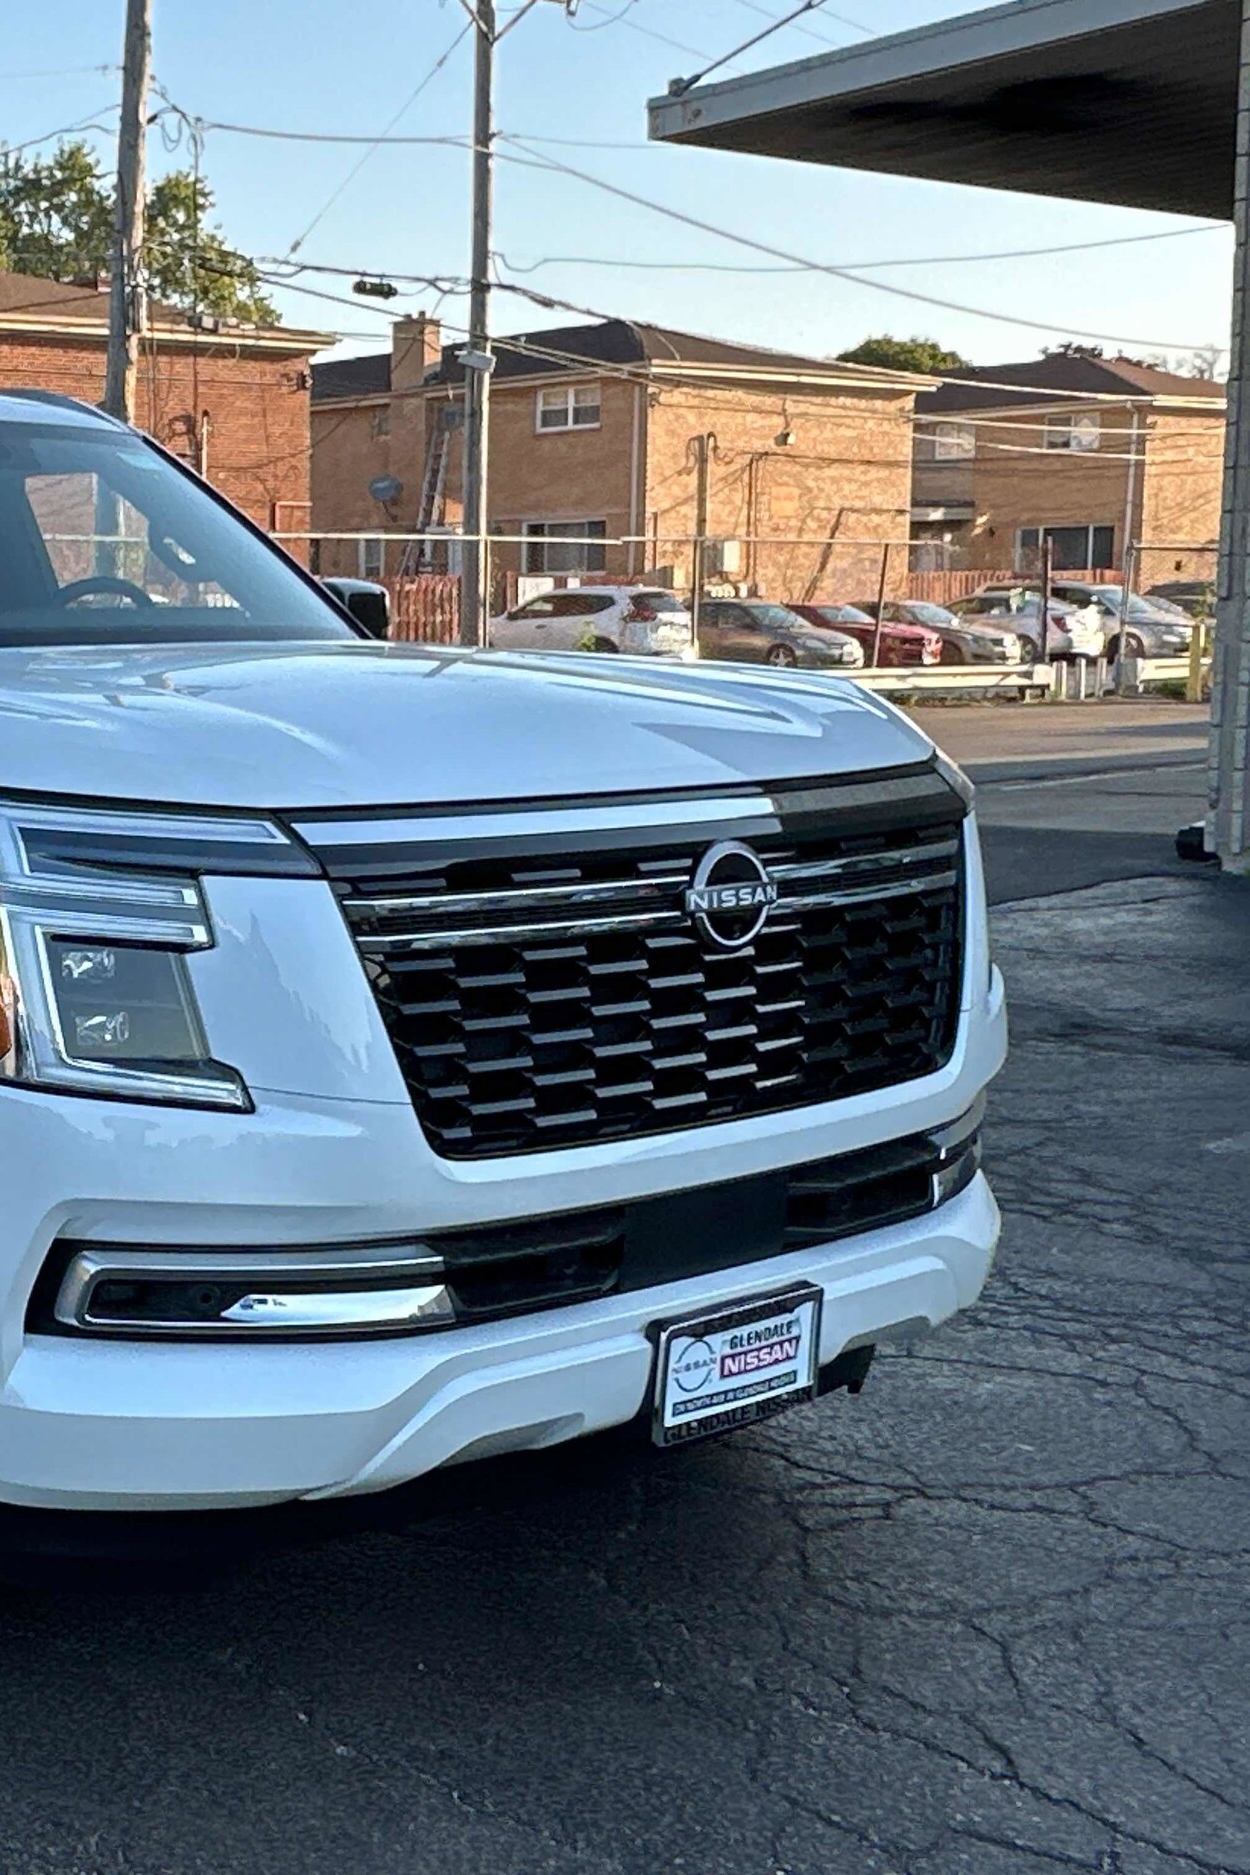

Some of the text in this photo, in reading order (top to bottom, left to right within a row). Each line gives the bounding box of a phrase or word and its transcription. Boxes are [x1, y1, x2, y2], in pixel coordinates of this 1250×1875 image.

[689, 883, 778, 911] NISSAN
[729, 1319, 794, 1350] GLENDALE
[671, 1356, 717, 1375] NISSAN
[722, 1338, 798, 1376] NISSAN
[664, 1405, 751, 1444] GLENDALE
